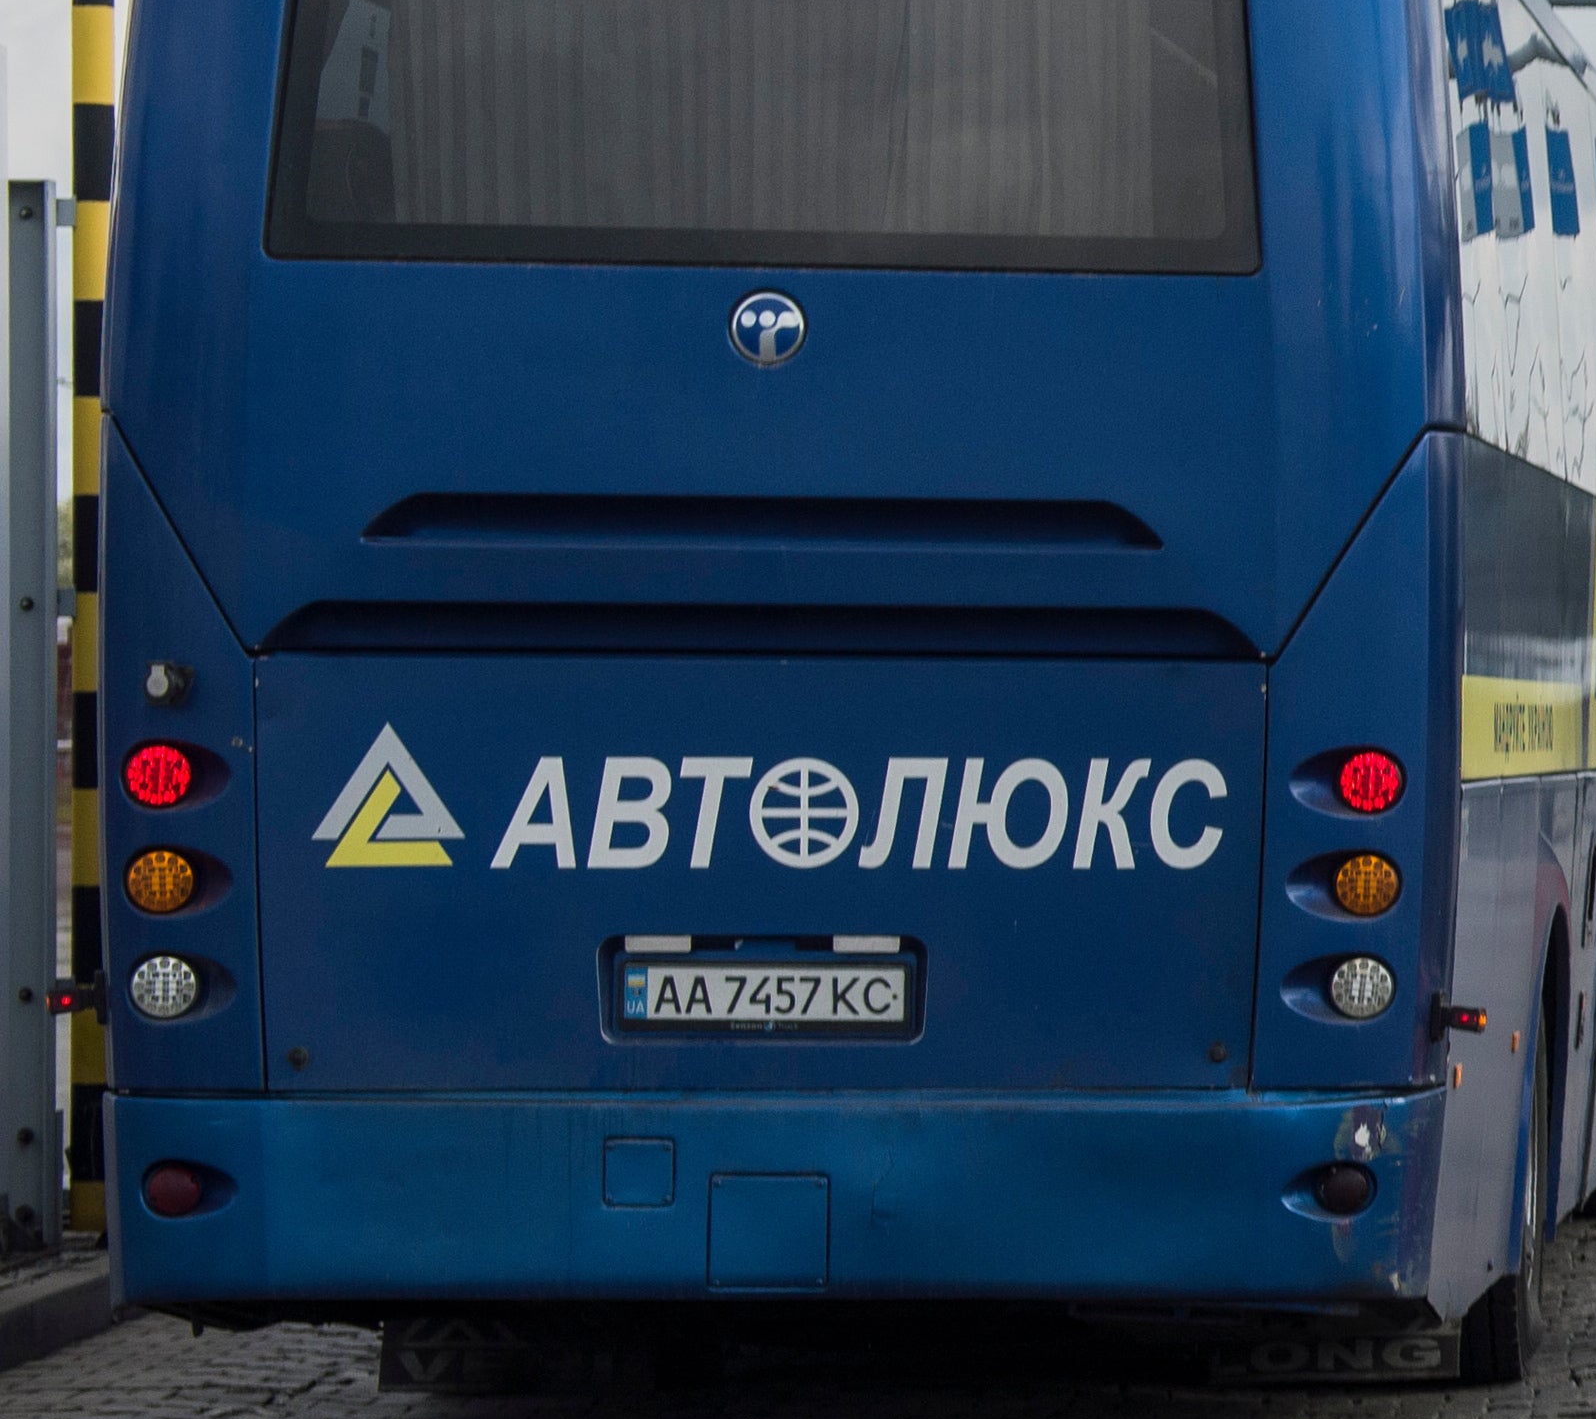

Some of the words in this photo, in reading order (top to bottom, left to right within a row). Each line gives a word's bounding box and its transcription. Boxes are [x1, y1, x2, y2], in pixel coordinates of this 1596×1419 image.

[490, 756, 1228, 870] АВТОЛЮКС
[626, 999, 646, 1015] UA
[653, 975, 713, 1015] AA
[724, 975, 822, 1016] 7457
[831, 976, 892, 1016] KC
